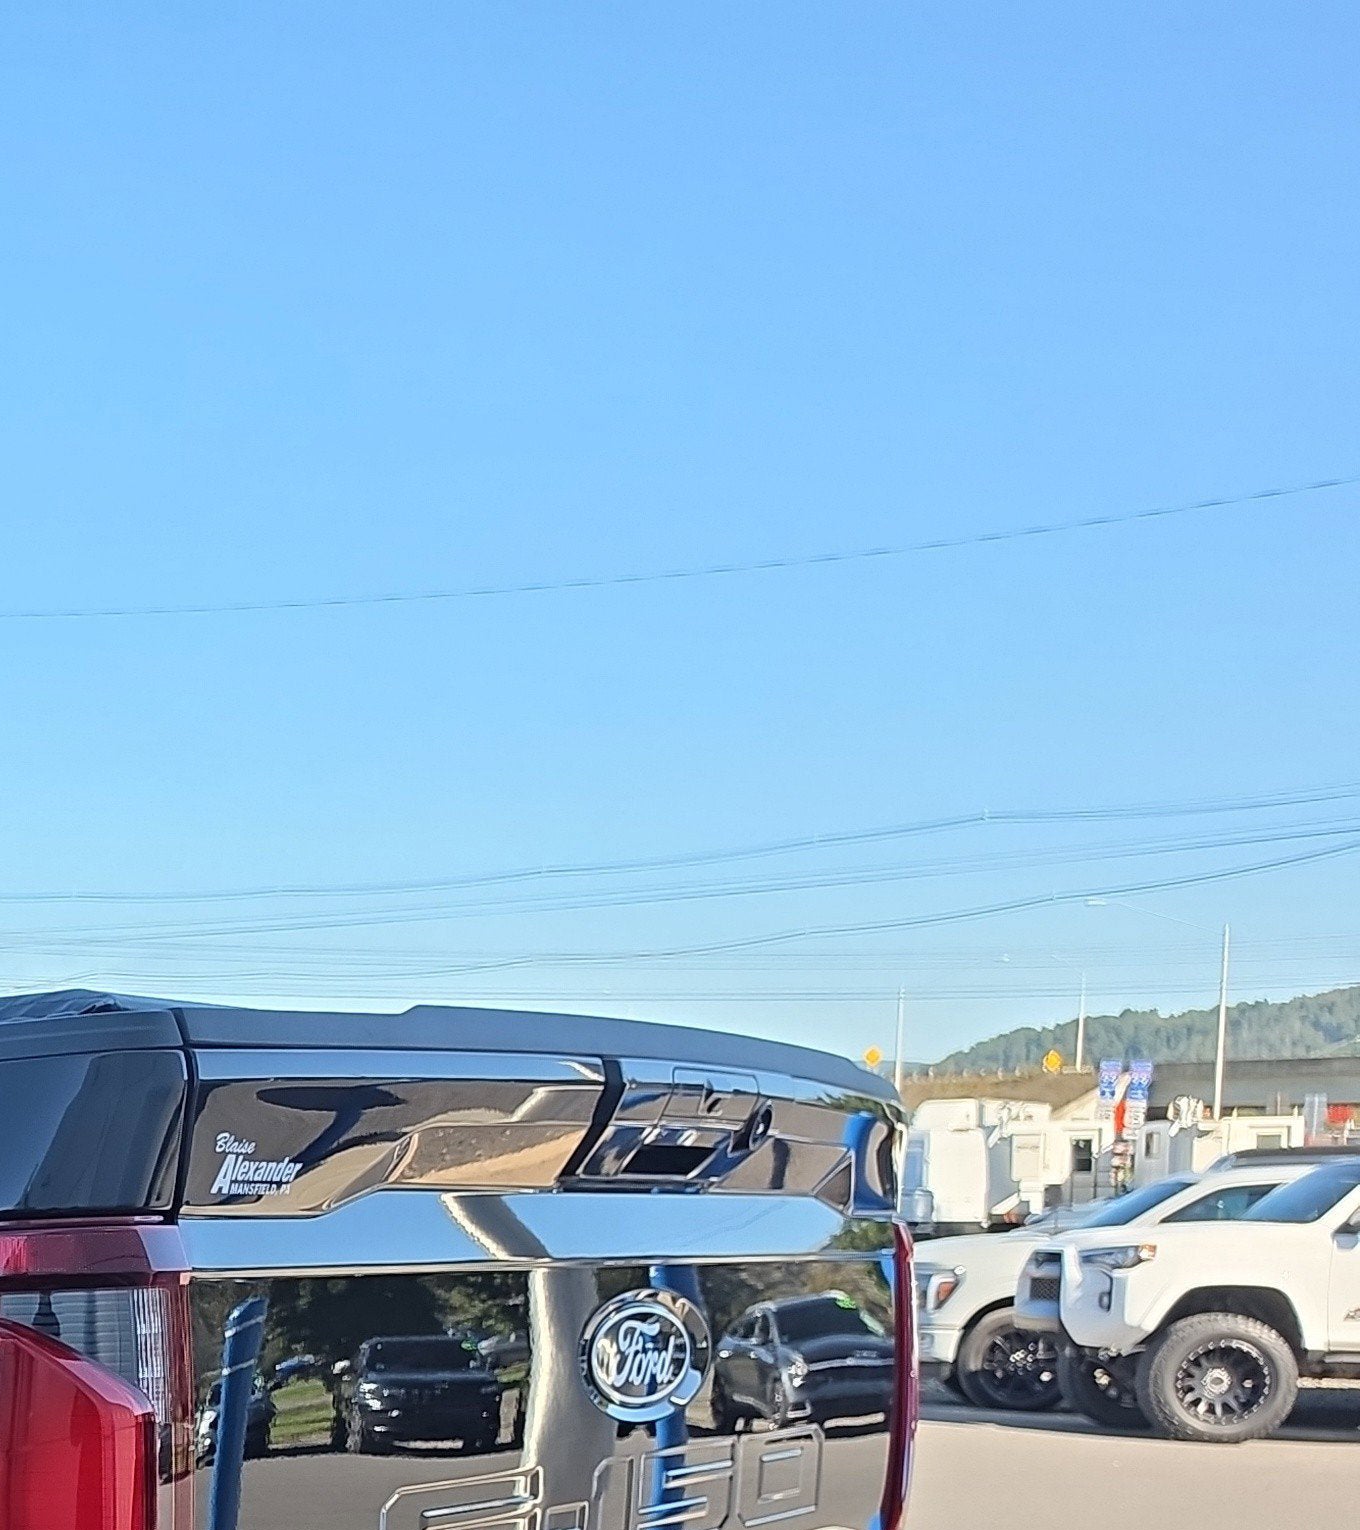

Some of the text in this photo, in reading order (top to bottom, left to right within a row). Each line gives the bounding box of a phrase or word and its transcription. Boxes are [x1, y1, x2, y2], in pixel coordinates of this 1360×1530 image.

[215, 1132, 256, 1153] Blaise
[210, 1154, 303, 1194] Alexander
[230, 1183, 278, 1195] MANSFIELD,
[612, 1319, 675, 1387] Ford
